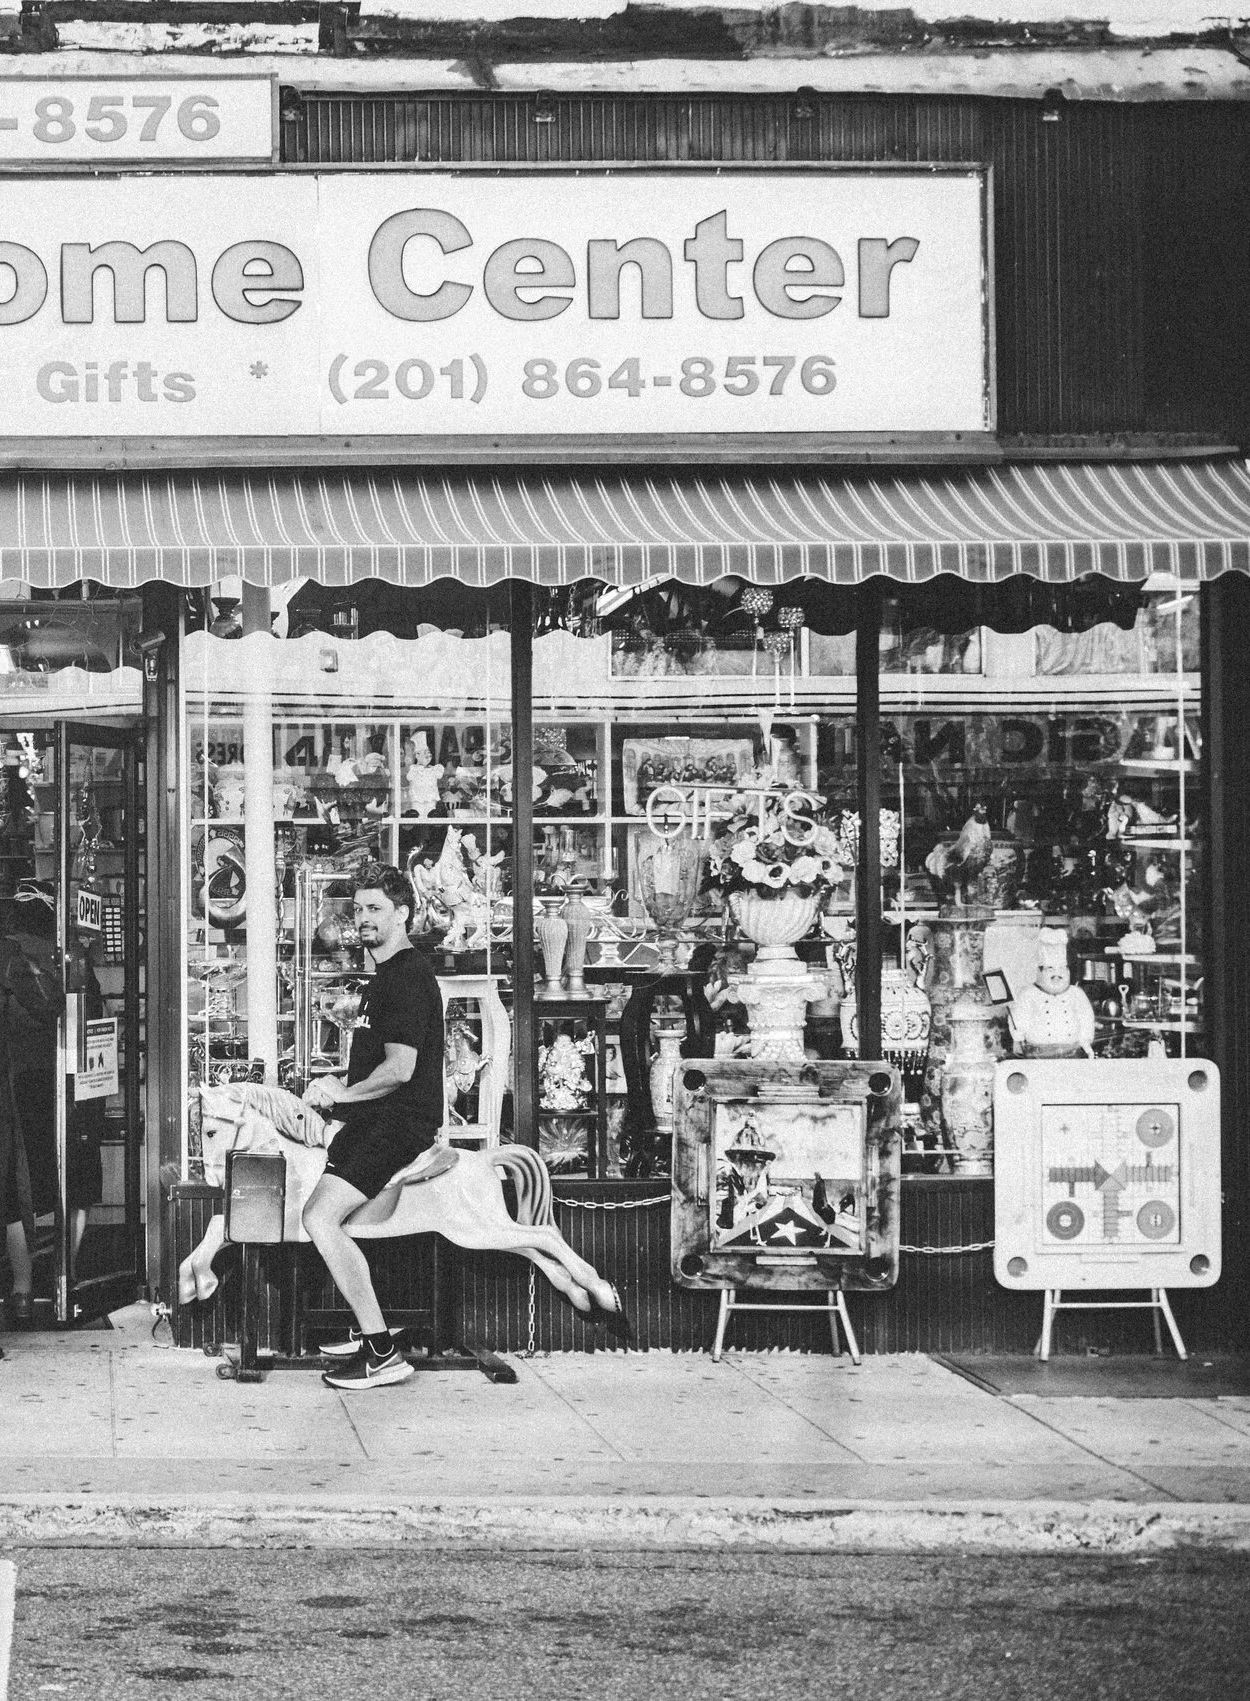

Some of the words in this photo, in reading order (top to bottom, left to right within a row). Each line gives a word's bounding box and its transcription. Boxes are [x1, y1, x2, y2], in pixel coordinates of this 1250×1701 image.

[366, 206, 922, 323] Center
[36, 361, 197, 404] Gifts
[328, 353, 488, 405] (201)
[521, 355, 838, 400] 864-8576
[646, 785, 818, 846] GIFTS
[79, 895, 100, 926] OPEN
